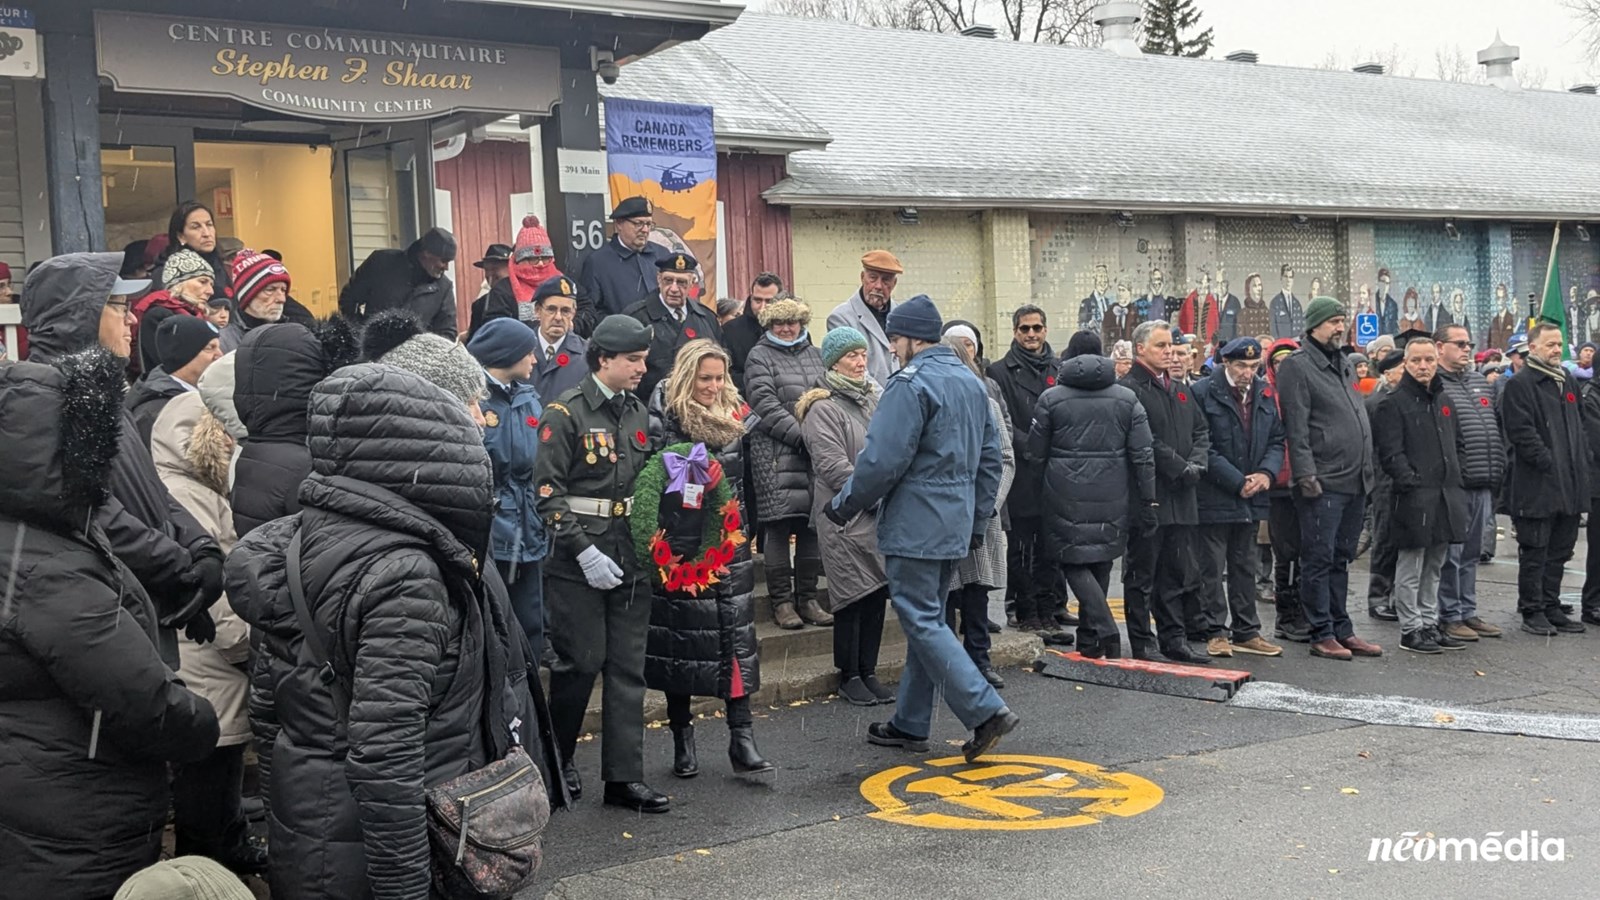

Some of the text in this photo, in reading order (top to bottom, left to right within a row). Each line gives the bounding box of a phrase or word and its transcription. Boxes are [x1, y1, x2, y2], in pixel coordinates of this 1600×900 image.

[168, 23, 507, 64] CENTRE COMMUNAUTAIRE
[211, 48, 329, 85] Stephen
[382, 60, 472, 90] Shaar
[262, 88, 433, 113] COMMUNITY CENTER
[635, 119, 687, 137] CANADA
[622, 134, 703, 152] REMEMBERS
[564, 165, 601, 175] 394 Main
[571, 219, 604, 250] 56
